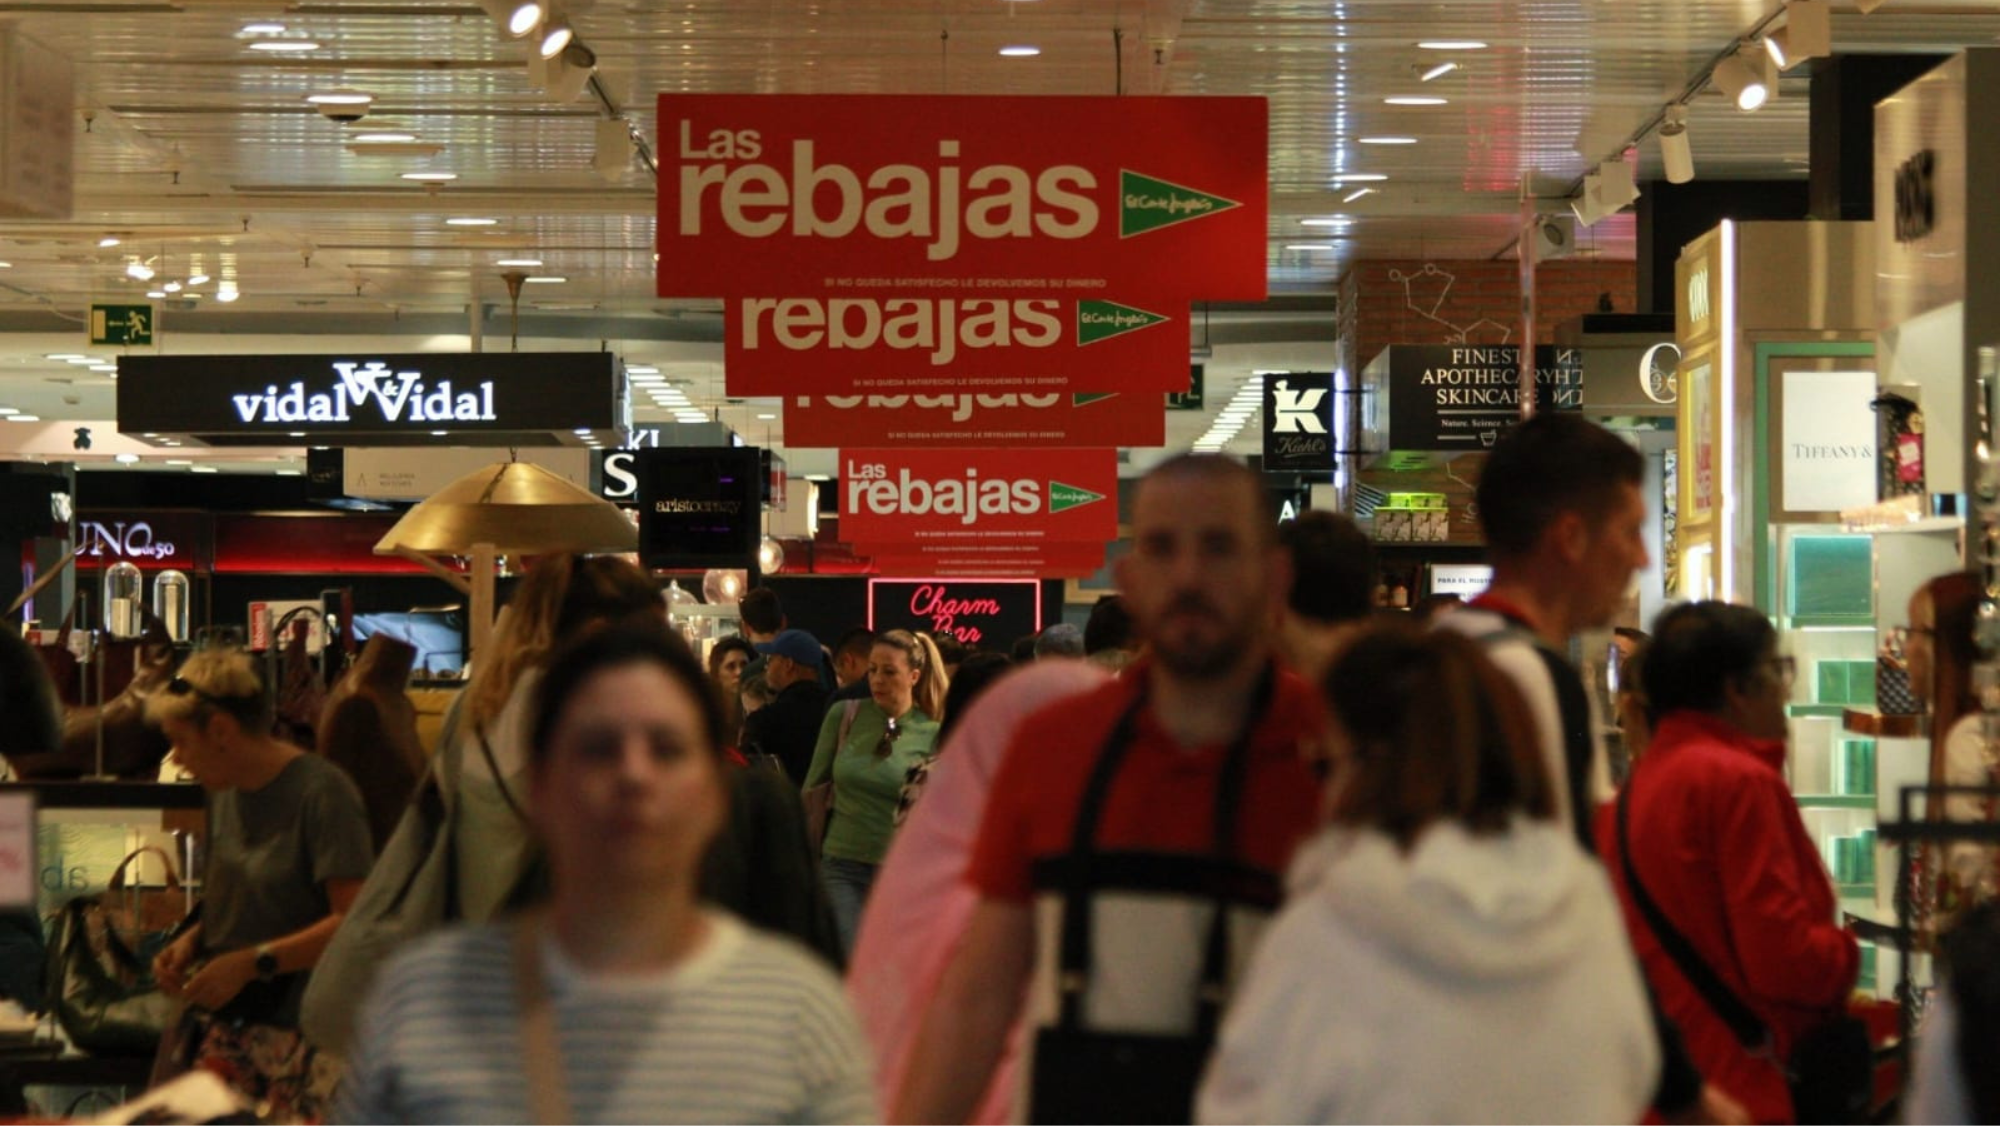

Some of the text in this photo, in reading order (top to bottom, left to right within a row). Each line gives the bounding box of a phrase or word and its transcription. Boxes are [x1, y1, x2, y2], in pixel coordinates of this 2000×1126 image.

[680, 119, 762, 159] Las
[680, 140, 1099, 260] rebajas
[742, 299, 1062, 365] rebajas
[1452, 348, 1521, 364] FINEST
[848, 459, 886, 479] Las
[848, 468, 1042, 525] rebajas
[911, 584, 1000, 616] Charm
